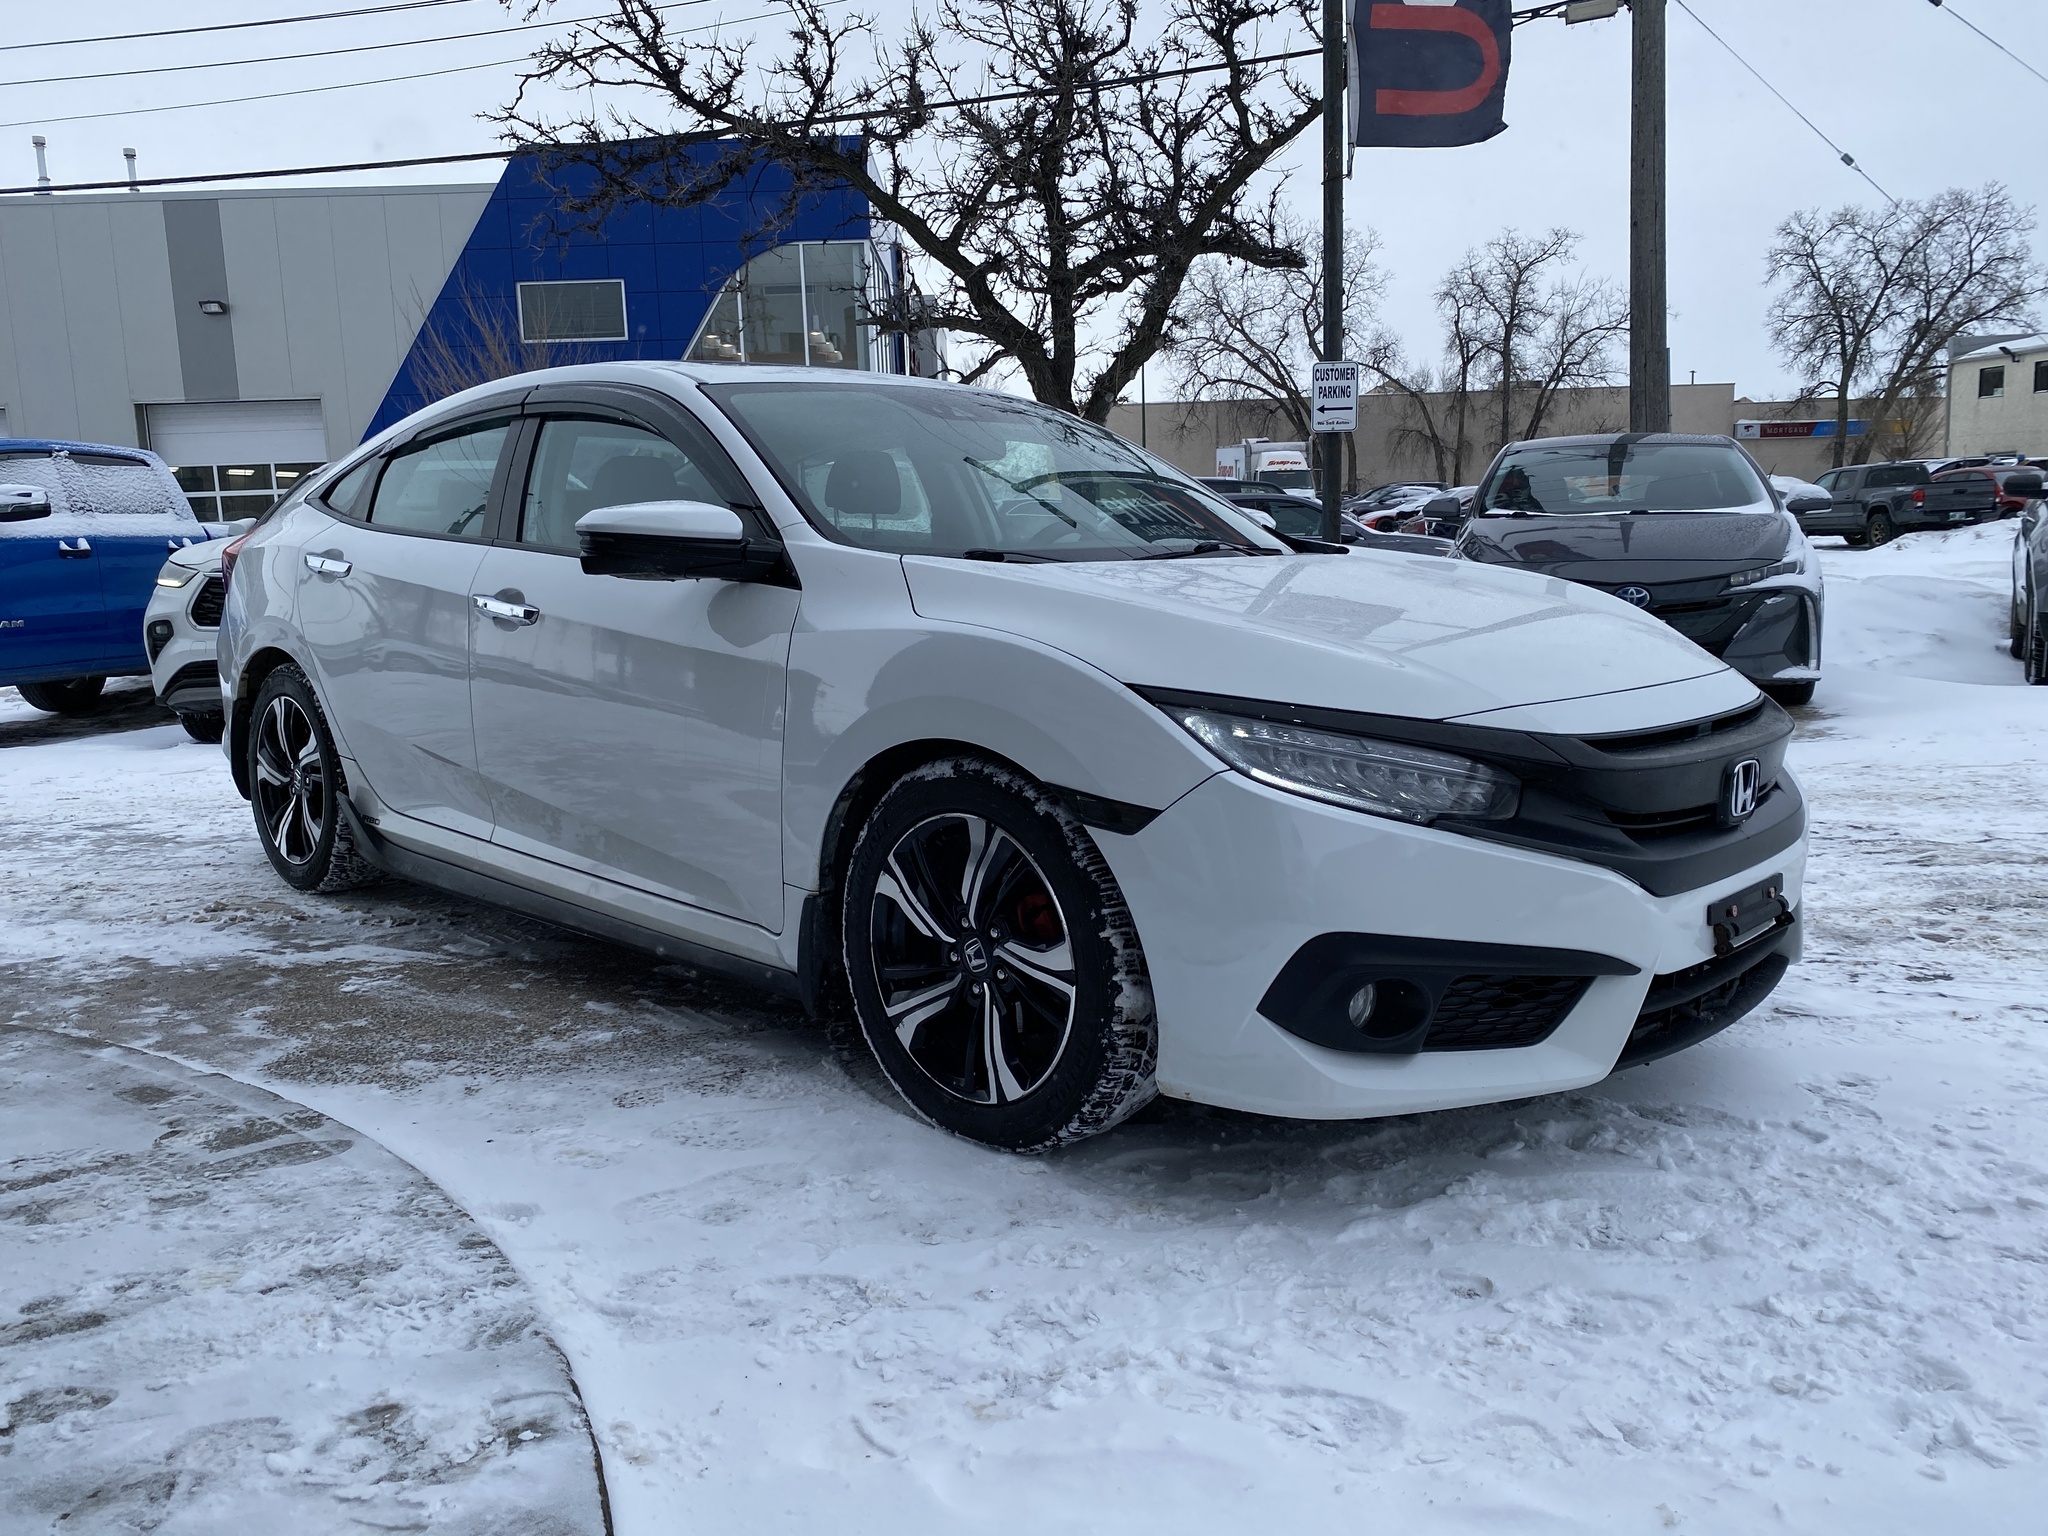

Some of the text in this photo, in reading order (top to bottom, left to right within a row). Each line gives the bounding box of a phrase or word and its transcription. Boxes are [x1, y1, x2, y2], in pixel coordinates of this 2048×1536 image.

[1315, 368, 1355, 381] CUSTOMER
[1318, 385, 1351, 399] PARKING
[0, 620, 24, 628] AM
[358, 813, 380, 825] URBO
